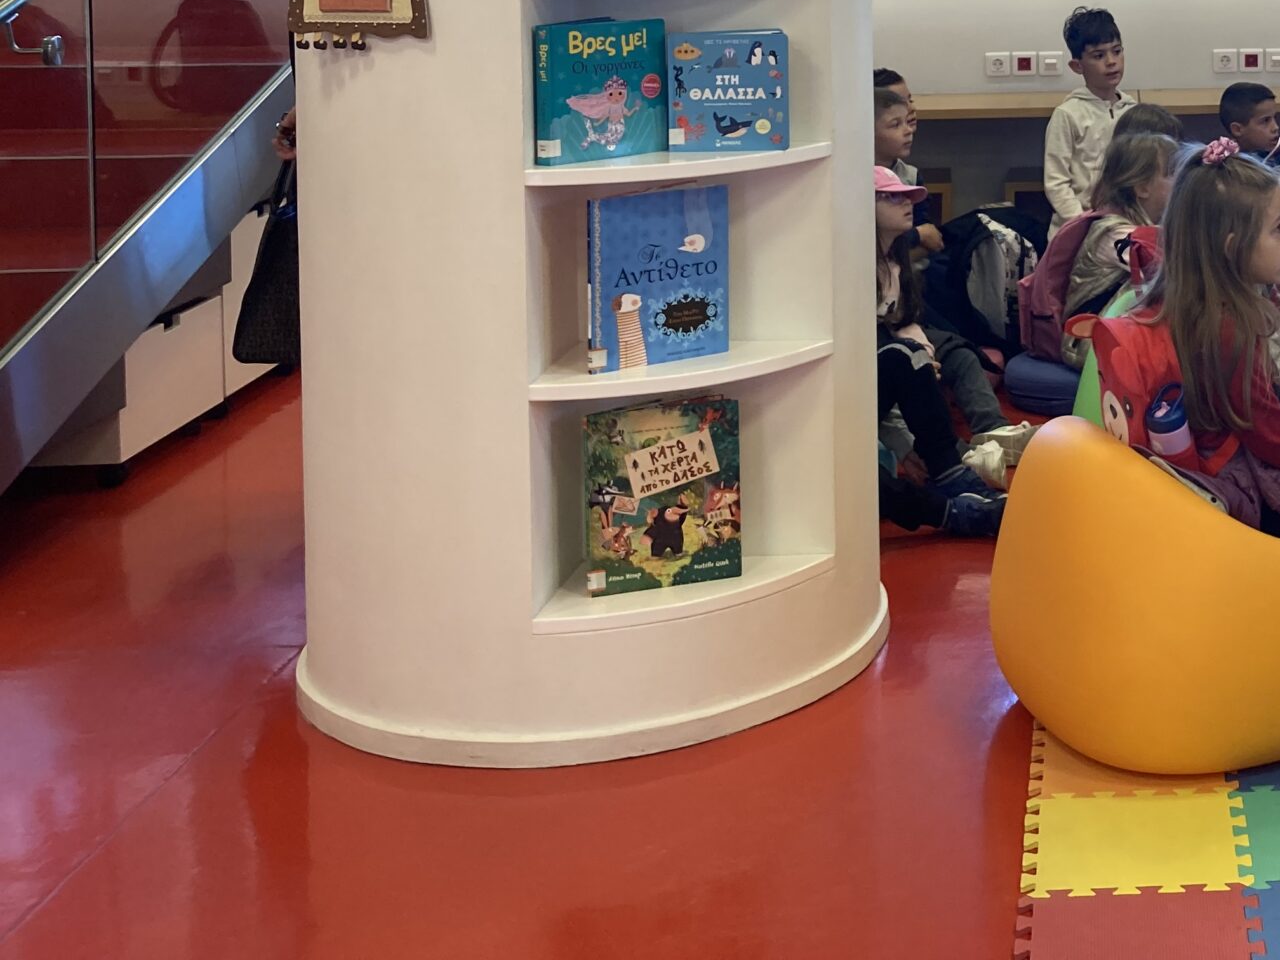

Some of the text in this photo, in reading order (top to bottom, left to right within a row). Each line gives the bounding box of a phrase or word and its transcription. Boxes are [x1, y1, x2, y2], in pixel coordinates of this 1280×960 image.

[568, 28, 647, 59] Βρες με!
[572, 60, 645, 75] Οι γοργόνες
[715, 75, 740, 85] ΣΤΗ
[689, 87, 767, 100] ΘΑΛΑΣΣΑ
[614, 258, 718, 289] Αντίθετο
